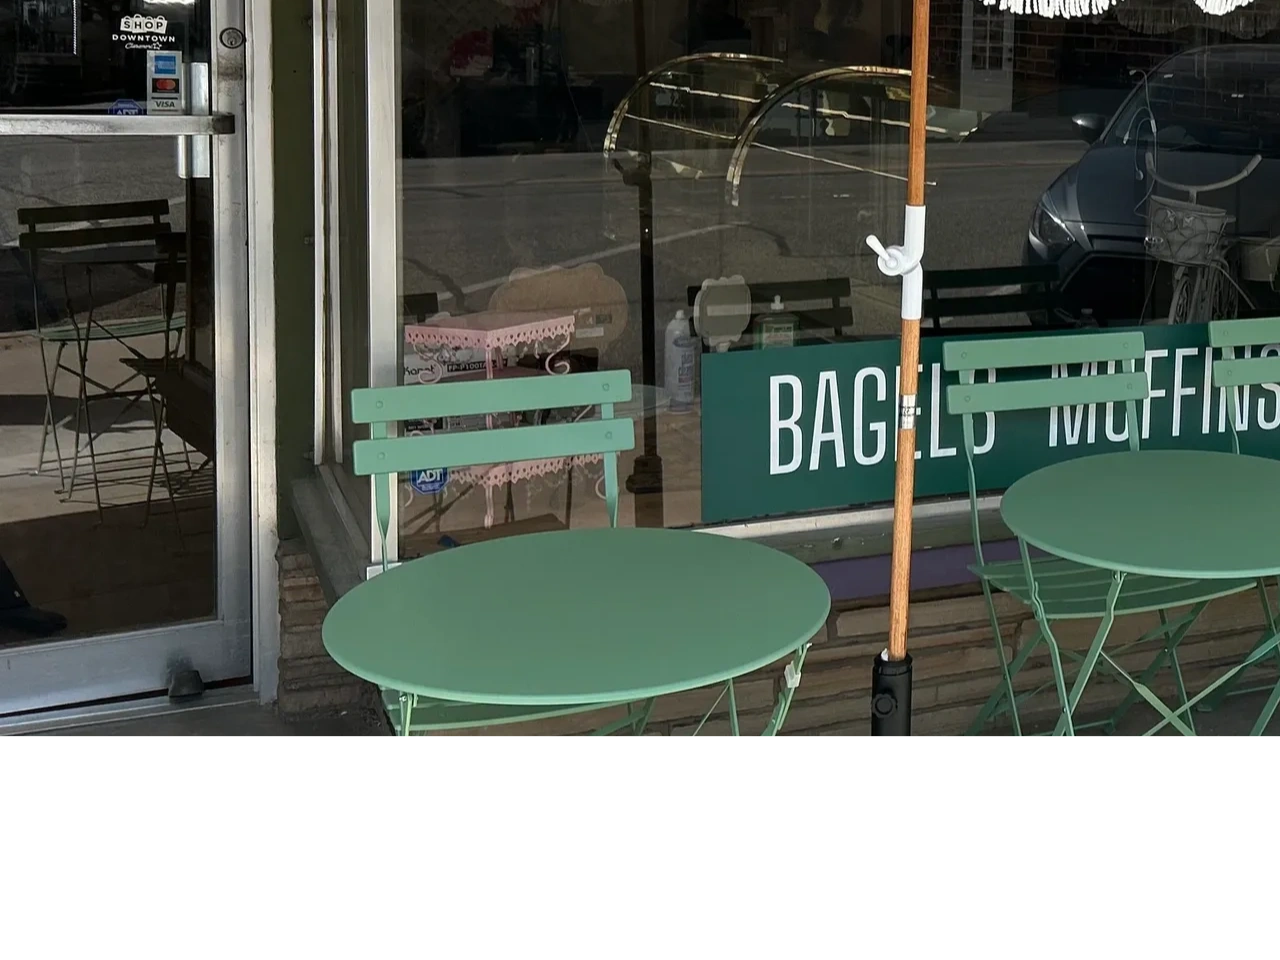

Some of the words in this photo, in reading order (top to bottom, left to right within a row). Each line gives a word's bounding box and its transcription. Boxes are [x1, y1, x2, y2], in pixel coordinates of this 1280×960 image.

[124, 20, 164, 30] SHOP
[112, 34, 175, 43] DOWNTOWN
[417, 468, 442, 483] ADT
